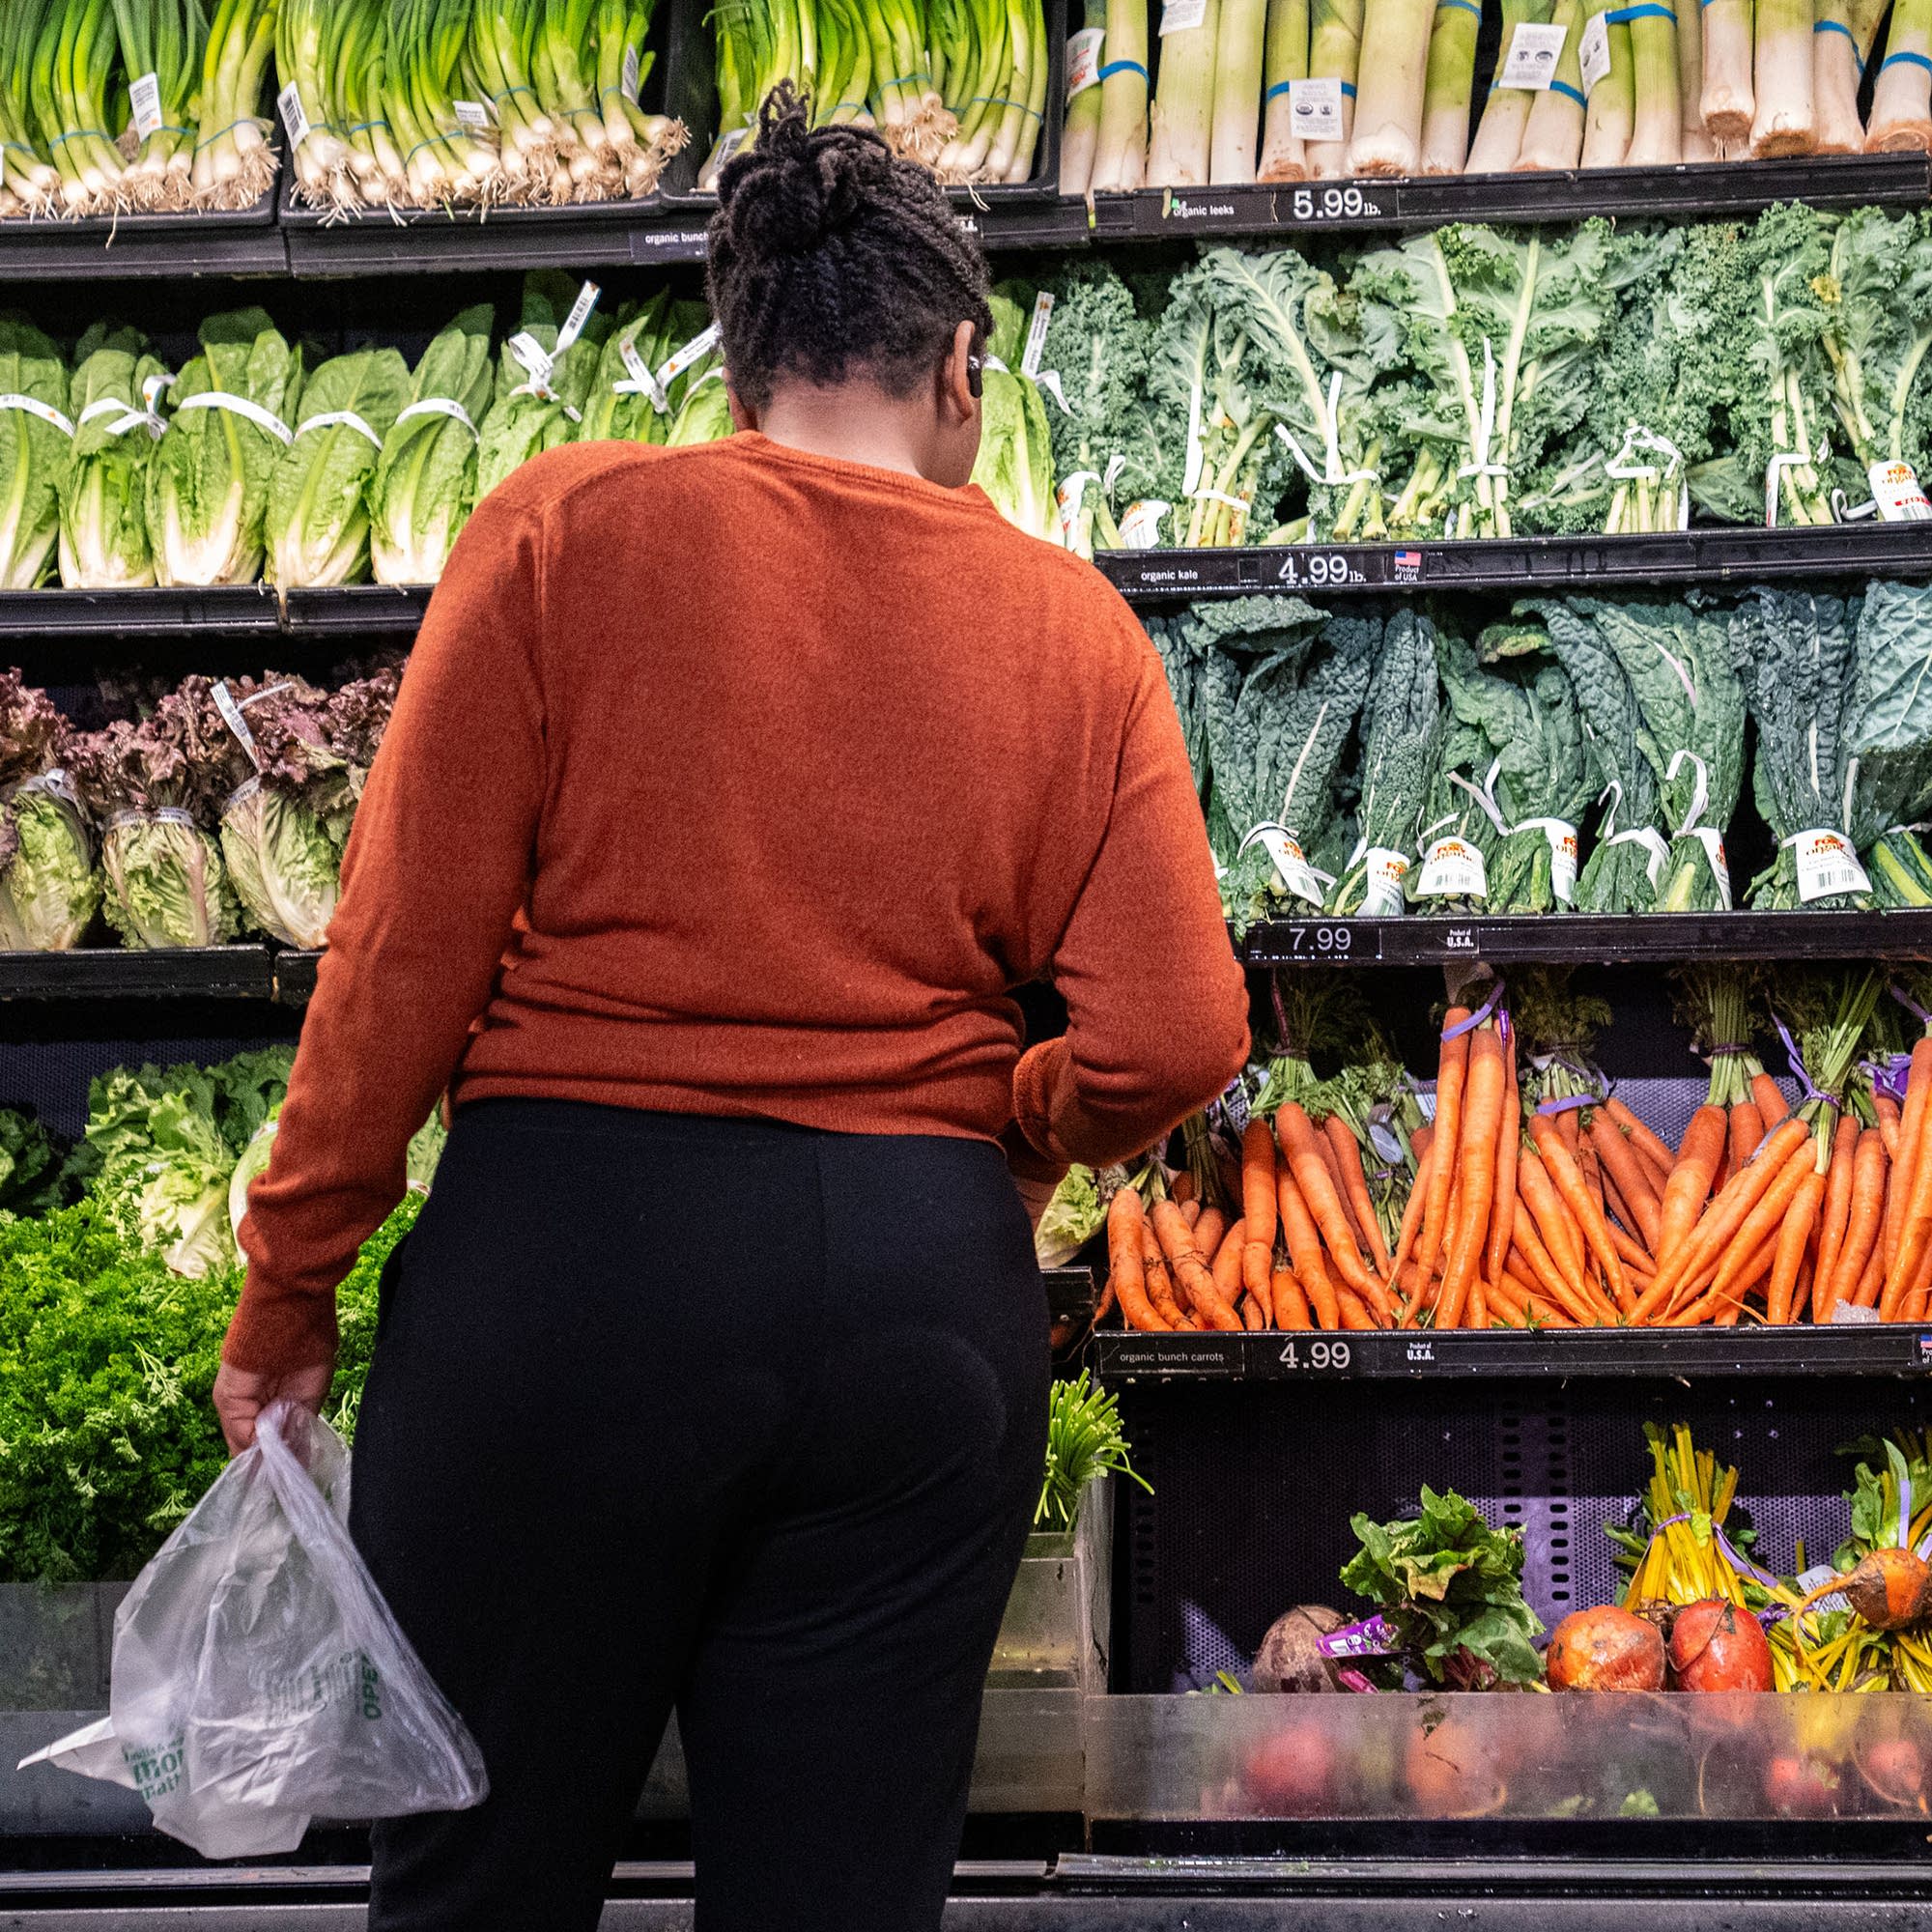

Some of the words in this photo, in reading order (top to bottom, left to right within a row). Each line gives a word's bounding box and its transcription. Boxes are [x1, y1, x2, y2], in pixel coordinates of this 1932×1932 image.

[1209, 205, 1235, 215] leeks
[644, 233, 679, 245] organic
[681, 232, 709, 242] bunch
[1395, 564, 1419, 574] Product
[1141, 569, 1177, 582] organic
[1179, 569, 1198, 580] kale
[1403, 573, 1418, 582] USA
[1289, 927, 1351, 951] 7.99
[1447, 936, 1474, 947] U.S.A.
[1120, 1352, 1155, 1363] organic
[1158, 1352, 1188, 1362] bunch
[1190, 1353, 1225, 1362] carrots
[1279, 1342, 1350, 1369] 4.99
[1406, 1350, 1435, 1361] U.S.A.
